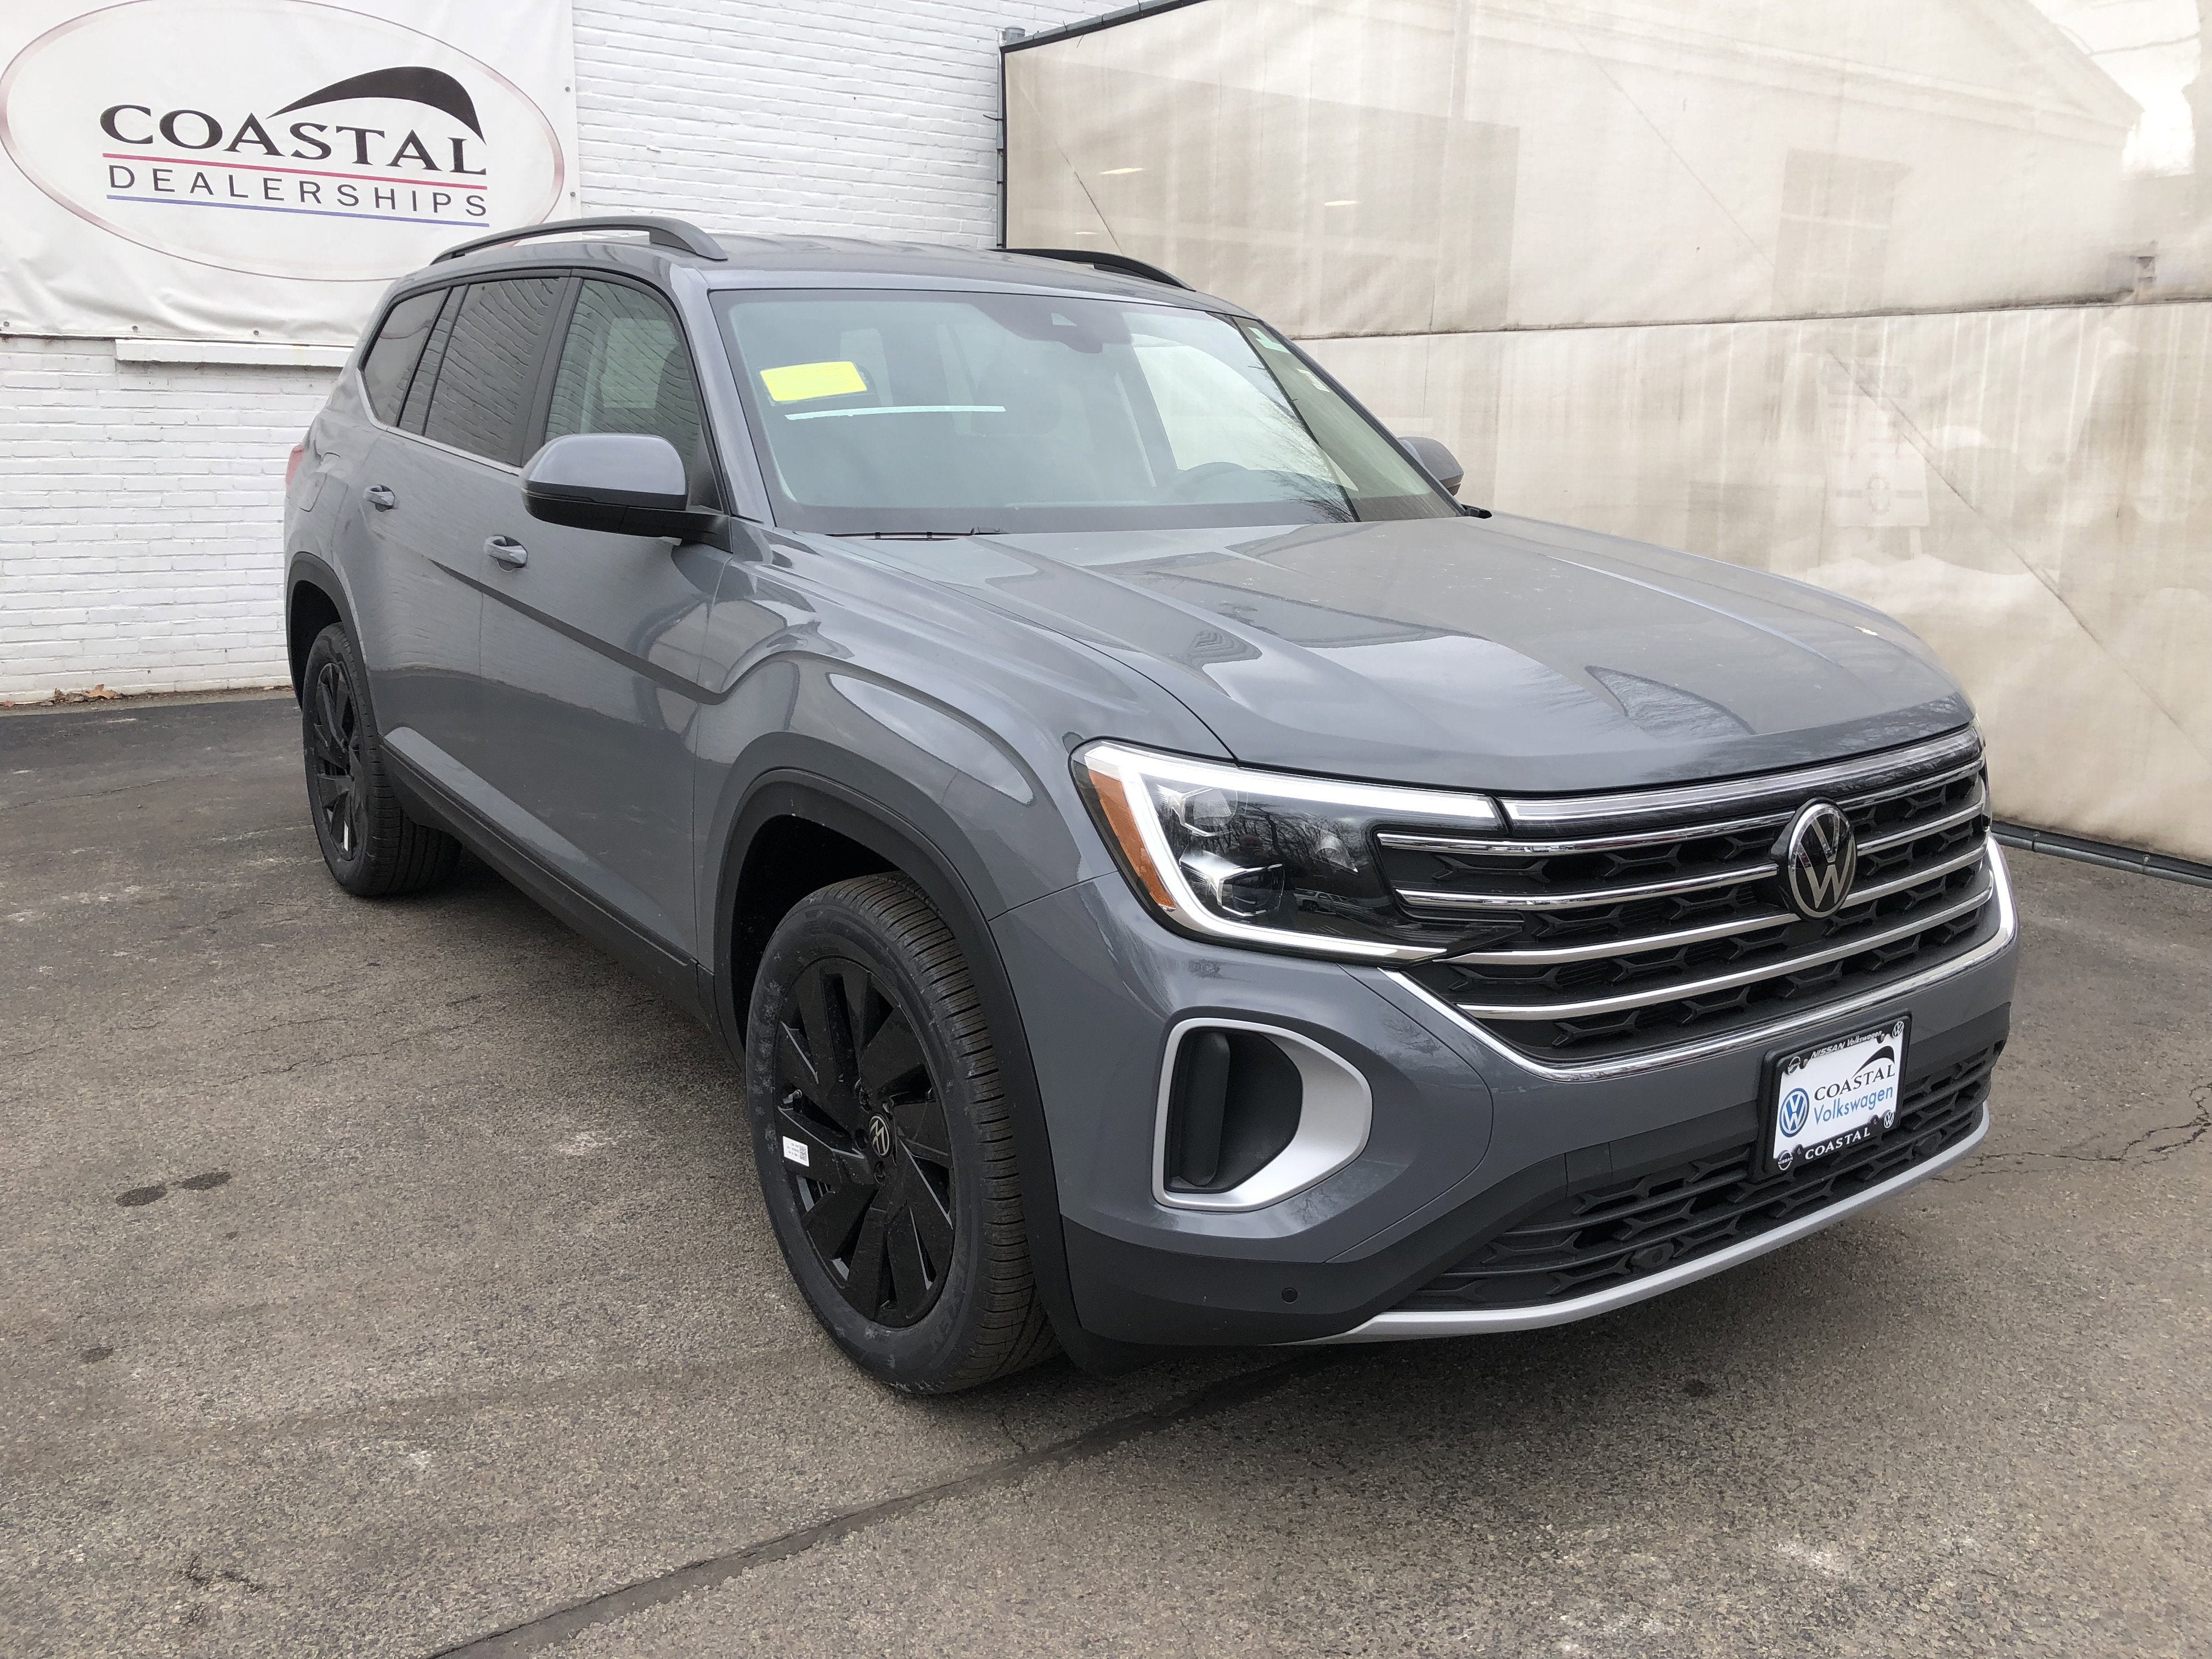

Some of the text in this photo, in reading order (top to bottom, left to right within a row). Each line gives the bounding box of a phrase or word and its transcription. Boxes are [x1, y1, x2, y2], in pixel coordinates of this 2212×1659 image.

[100, 104, 487, 176] COASTAL
[108, 164, 487, 216] DEALERSHIPS
[1810, 1030, 1882, 1059] NISSAN Volkswagen
[1814, 1064, 1895, 1101] COASTAL
[1813, 1086, 1893, 1125] Volkswagen
[1804, 1127, 1871, 1160] COASTAL
